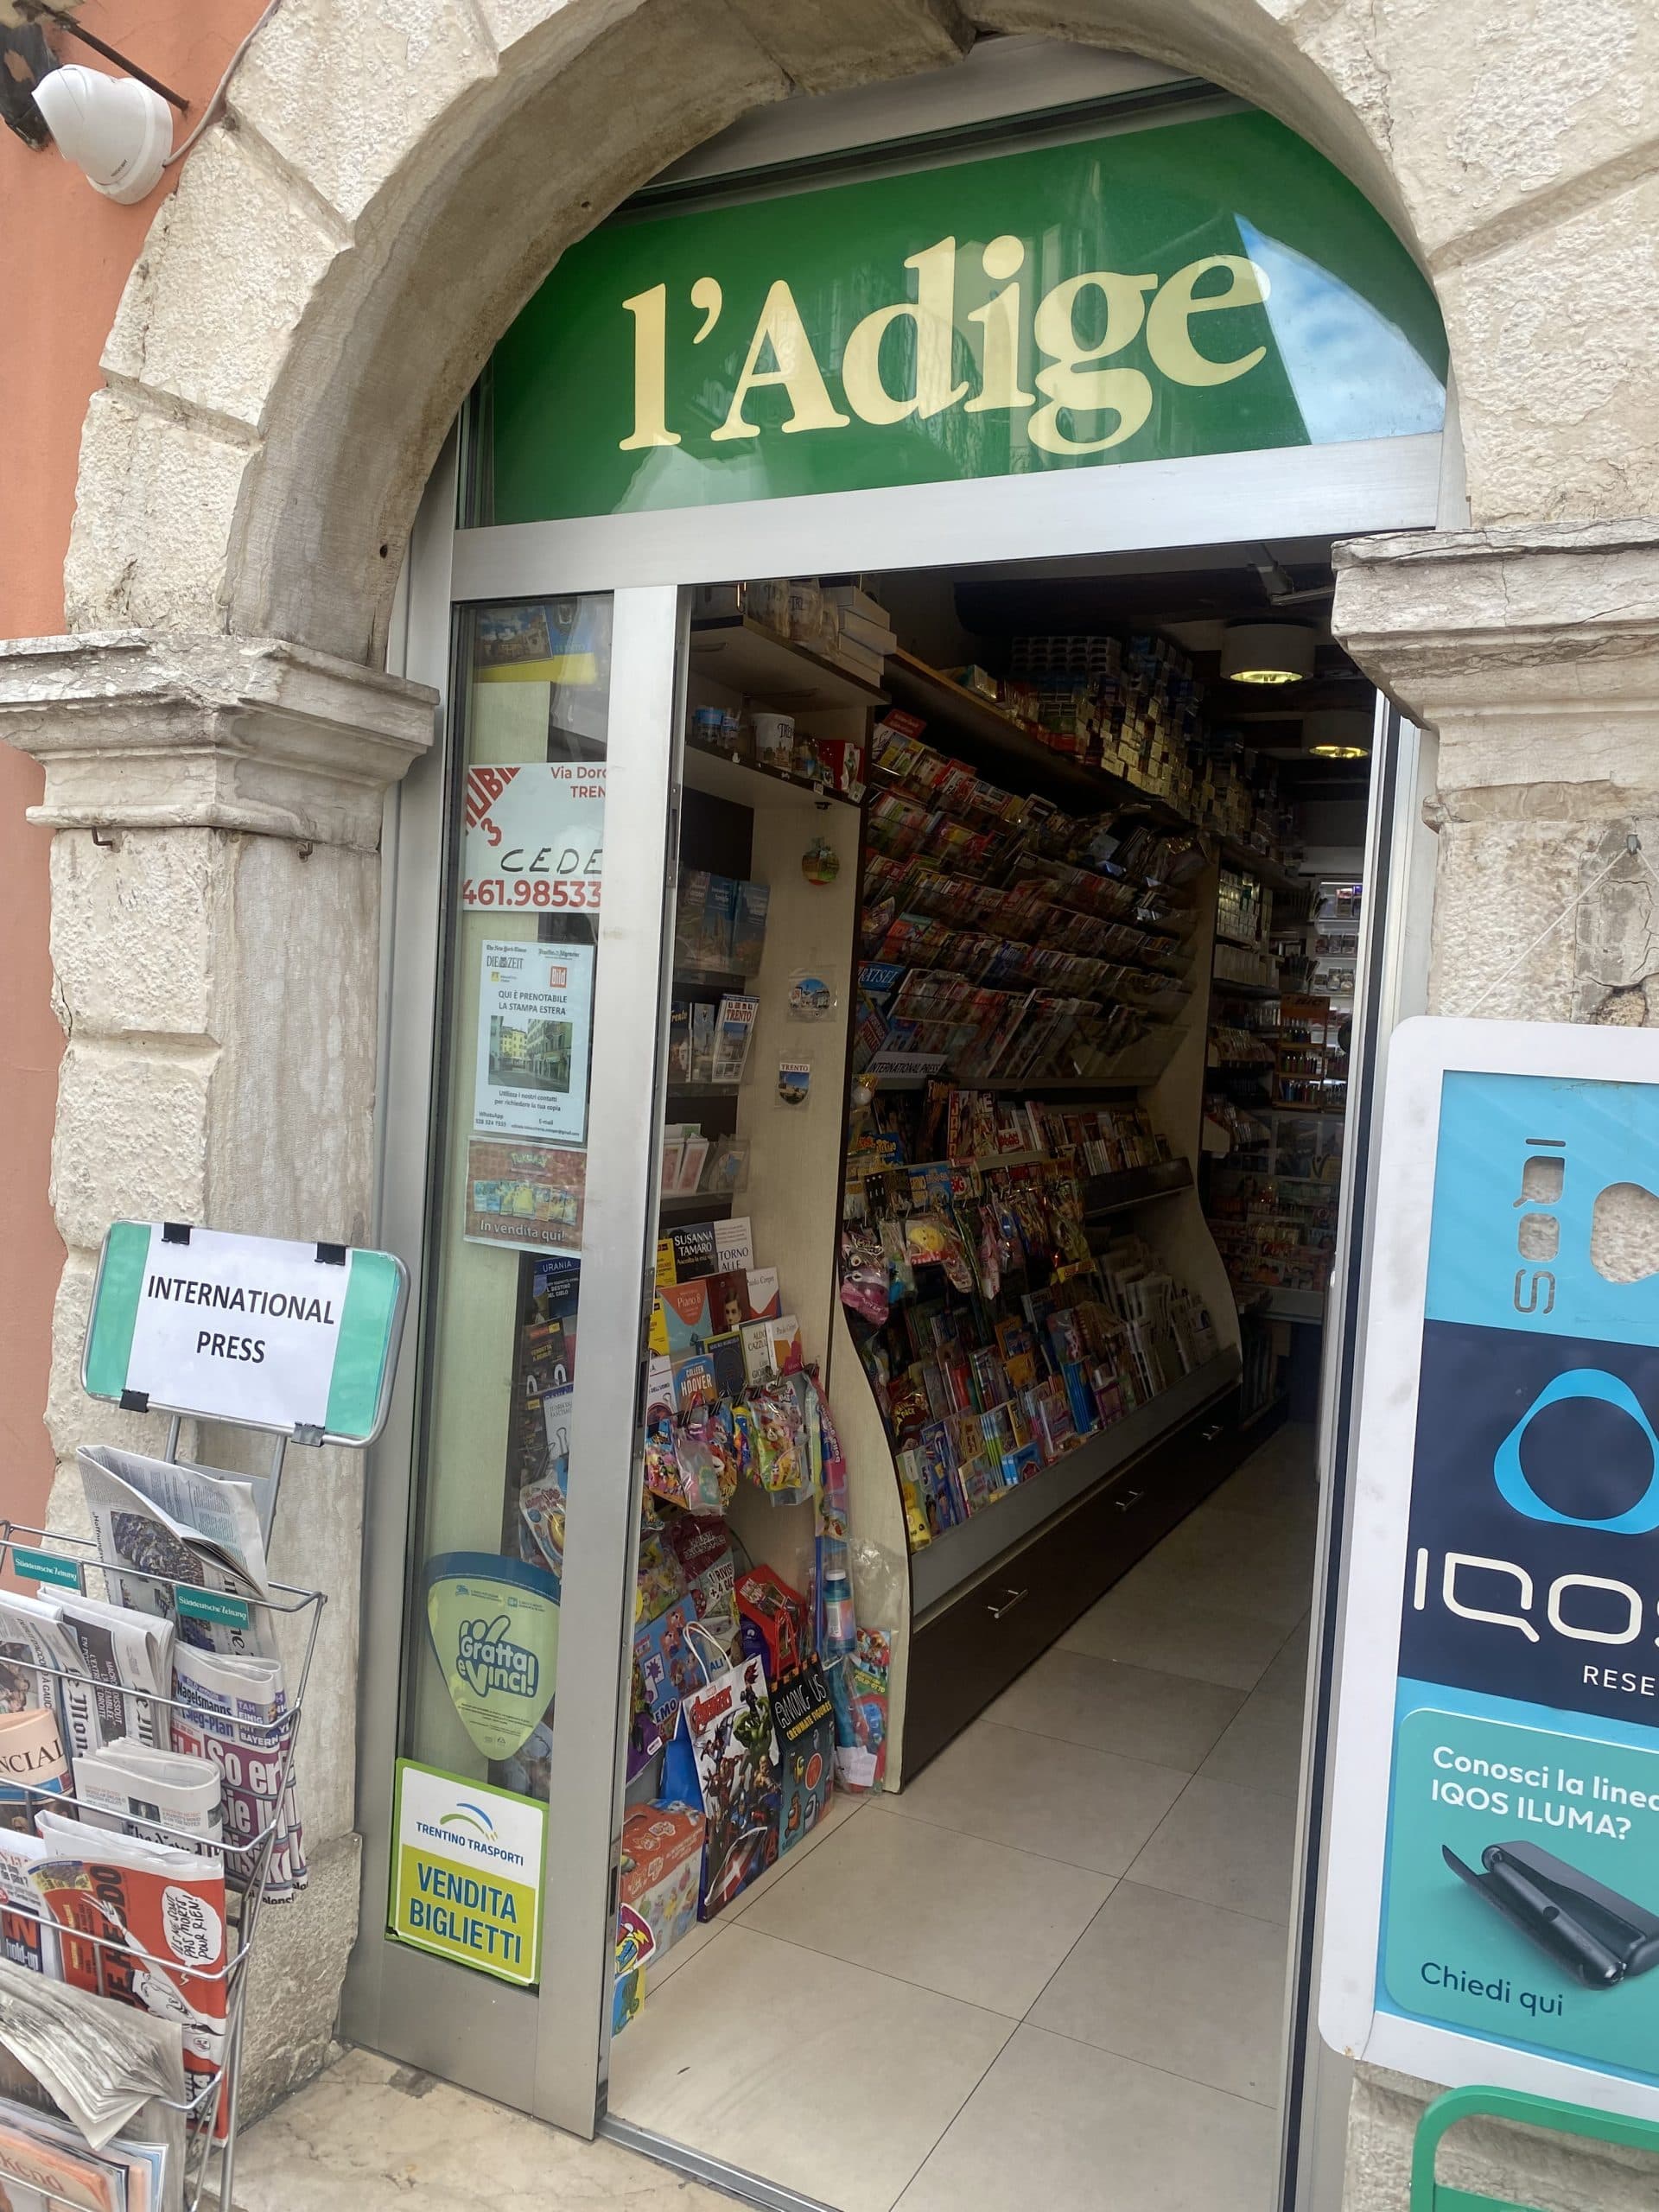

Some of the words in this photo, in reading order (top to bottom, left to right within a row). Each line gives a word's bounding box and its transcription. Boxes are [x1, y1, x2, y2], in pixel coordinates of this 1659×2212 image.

[619, 233, 1270, 455] l'Adige
[551, 766, 572, 779] Via
[486, 956, 499, 967] DIE
[507, 957, 524, 969] ZEIT
[498, 990, 512, 999] QUI
[513, 990, 518, 999] È
[519, 992, 568, 1003] PRENOTABILE
[509, 1002, 537, 1013] STAMPA
[539, 1006, 566, 1015] ESTERA
[726, 1009, 753, 1023] TRENTO
[781, 1063, 809, 1072] TRENTO
[480, 1220, 491, 1231] In
[493, 1224, 538, 1238] vendita
[542, 1230, 565, 1242] qui!
[674, 1230, 714, 1246] SUSANNA
[678, 1242, 712, 1257] TAMARO
[720, 1247, 749, 1261] TORNO
[543, 1260, 572, 1273] URANIA
[148, 1275, 334, 1325] INTERNATIONAL
[196, 1331, 265, 1363] PRESS
[680, 1376, 713, 1397] HOOVER
[15, 1557, 54, 1577] Süddeutsche
[54, 1567, 78, 1582] Zeitung
[178, 1596, 220, 1613] Süddeutsche
[220, 1607, 247, 1621] Zeitung
[1414, 1548, 1659, 1646] IQO
[461, 1636, 527, 1671] Gratta
[457, 1658, 467, 1675] e
[809, 1673, 827, 1702] US
[1583, 1666, 1655, 1696] RESE
[42, 1685, 53, 1709] GAUC
[177, 1681, 232, 1715] Nagelsmanns
[69, 1689, 89, 1758] Mon
[240, 1732, 279, 1745] BAYERN
[207, 1739, 242, 1787] So
[1433, 1745, 1549, 1789] Conosci
[1556, 1770, 1584, 1796] la
[1431, 1777, 1510, 1815] IQOS
[1516, 1796, 1632, 1840] ILUMA?
[416, 1821, 465, 1847] TRENTINO
[467, 1838, 524, 1866] TRASPORTI
[417, 1862, 517, 1924] VENDITA
[175, 1897, 194, 1936] MORTS
[410, 1897, 522, 1964] BIGLIETTI
[182, 1938, 199, 1959] PAS
[194, 1935, 213, 1961] POUR
[1421, 1961, 1510, 2005] Chiedi
[1519, 1990, 1564, 2017] qui
